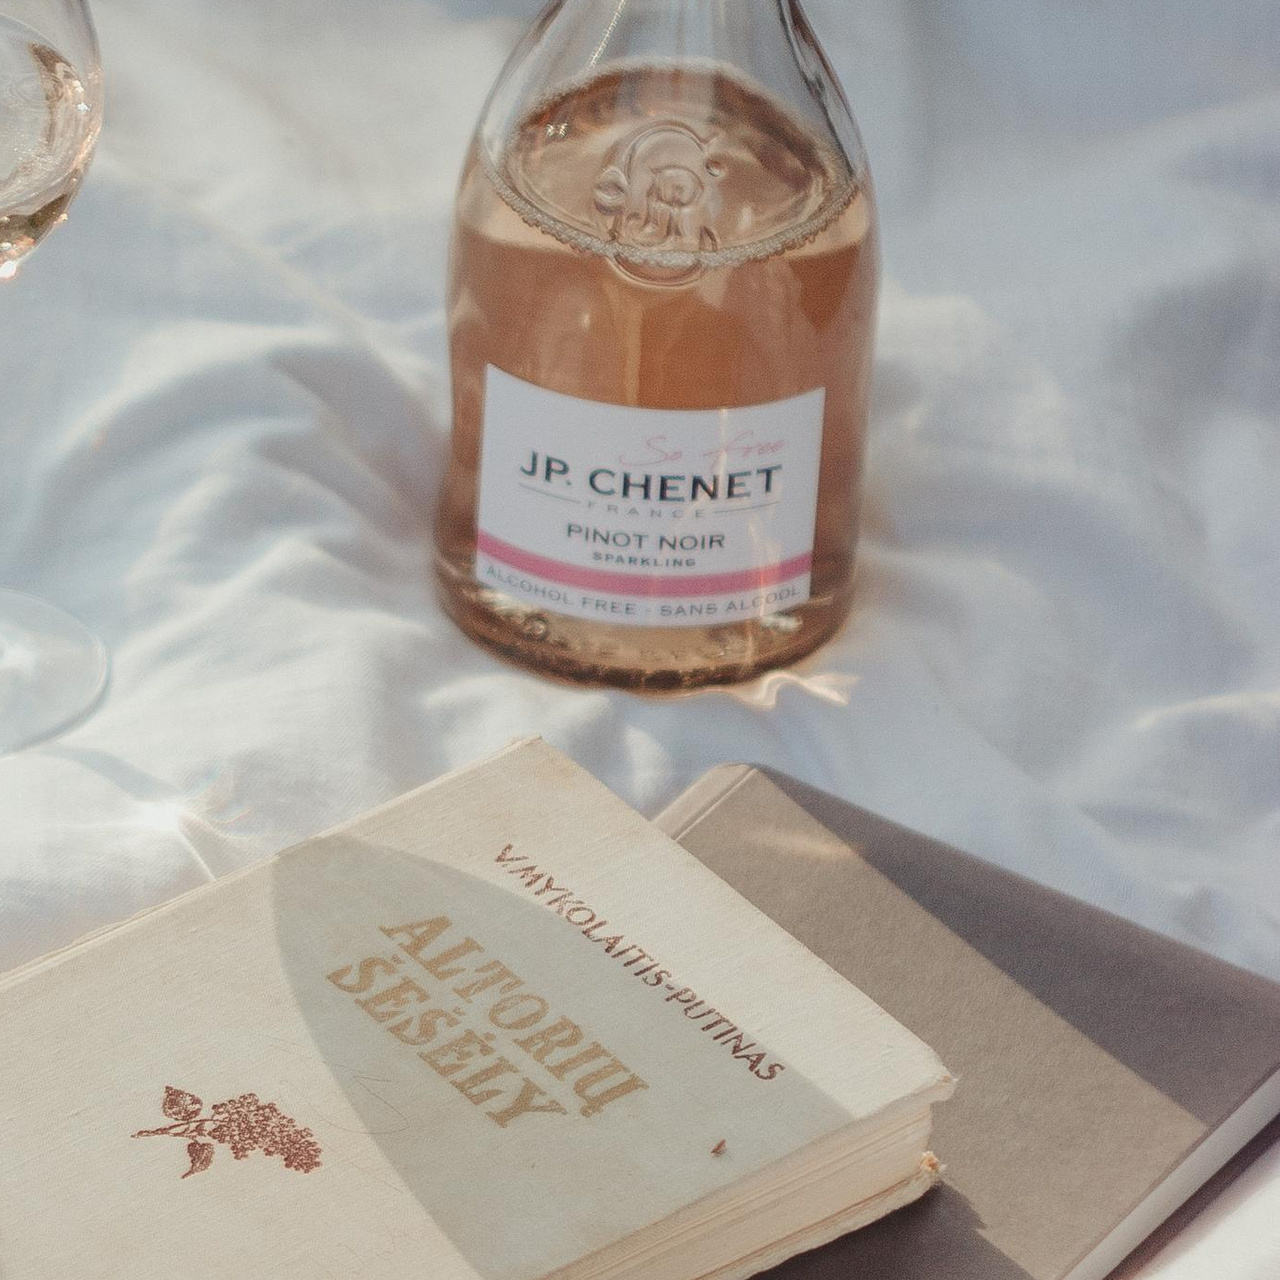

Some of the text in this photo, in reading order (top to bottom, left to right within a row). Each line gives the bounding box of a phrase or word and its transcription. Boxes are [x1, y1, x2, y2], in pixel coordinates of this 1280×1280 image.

[588, 463, 783, 503] CHENET
[587, 501, 709, 519] FRANCE
[566, 523, 726, 551] PINOT NOIR
[592, 551, 697, 568] SPARKLING
[486, 565, 574, 605] ALCOHOL
[581, 596, 638, 616] FREE
[659, 601, 718, 617] SANS
[378, 914, 650, 1118] ALTORIŲ
[324, 953, 569, 1129] ŠEŠĖLY
